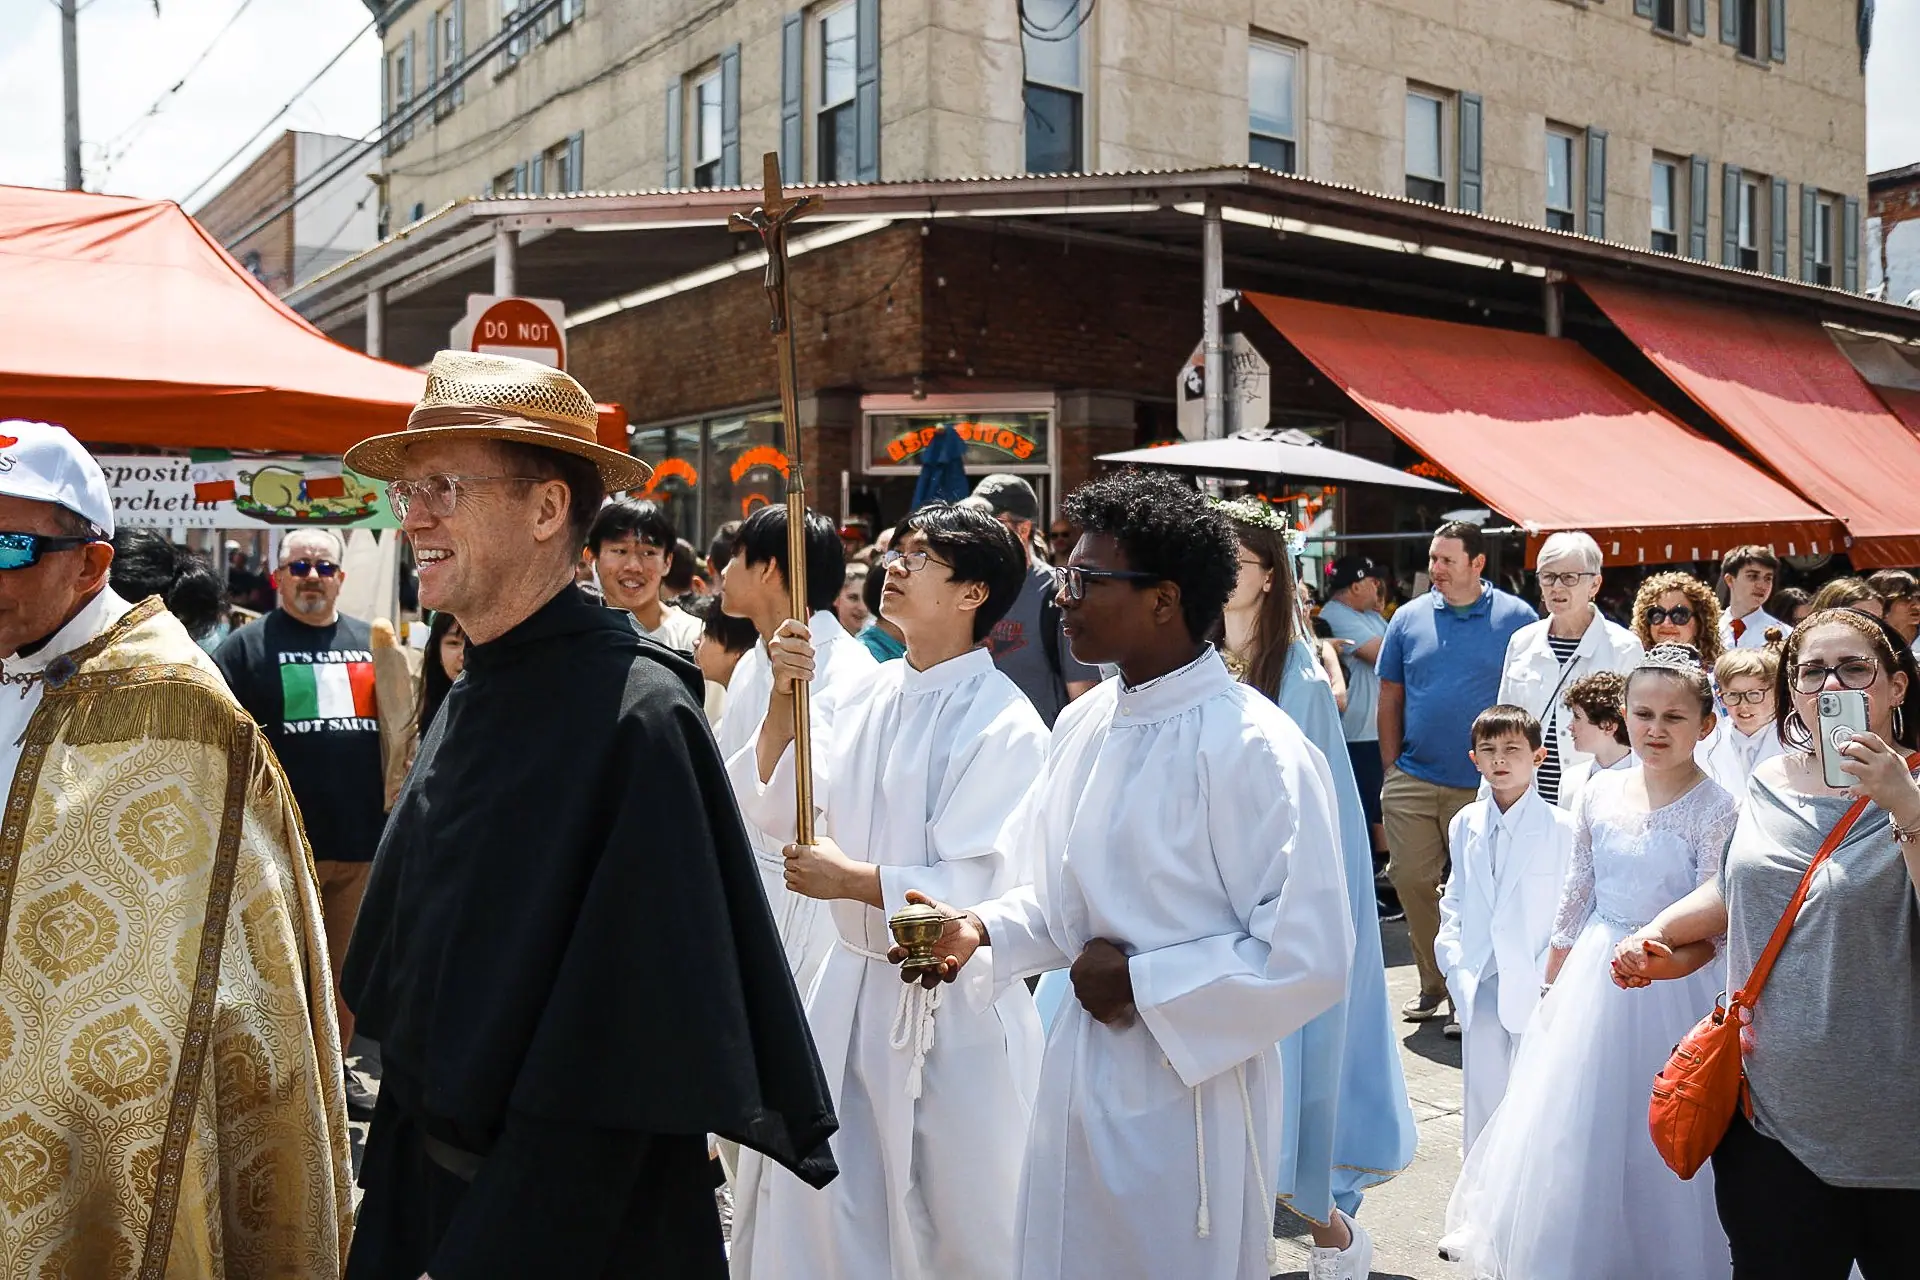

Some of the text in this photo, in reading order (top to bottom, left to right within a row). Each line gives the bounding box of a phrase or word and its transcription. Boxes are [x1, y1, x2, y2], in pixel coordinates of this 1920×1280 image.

[484, 321, 550, 341] DO NOT
[886, 422, 1035, 461] ESPSITO'S
[102, 460, 228, 488] sposito's
[119, 517, 157, 526] LIAN
[278, 651, 313, 664] IT'S
[283, 720, 325, 735] NOT
